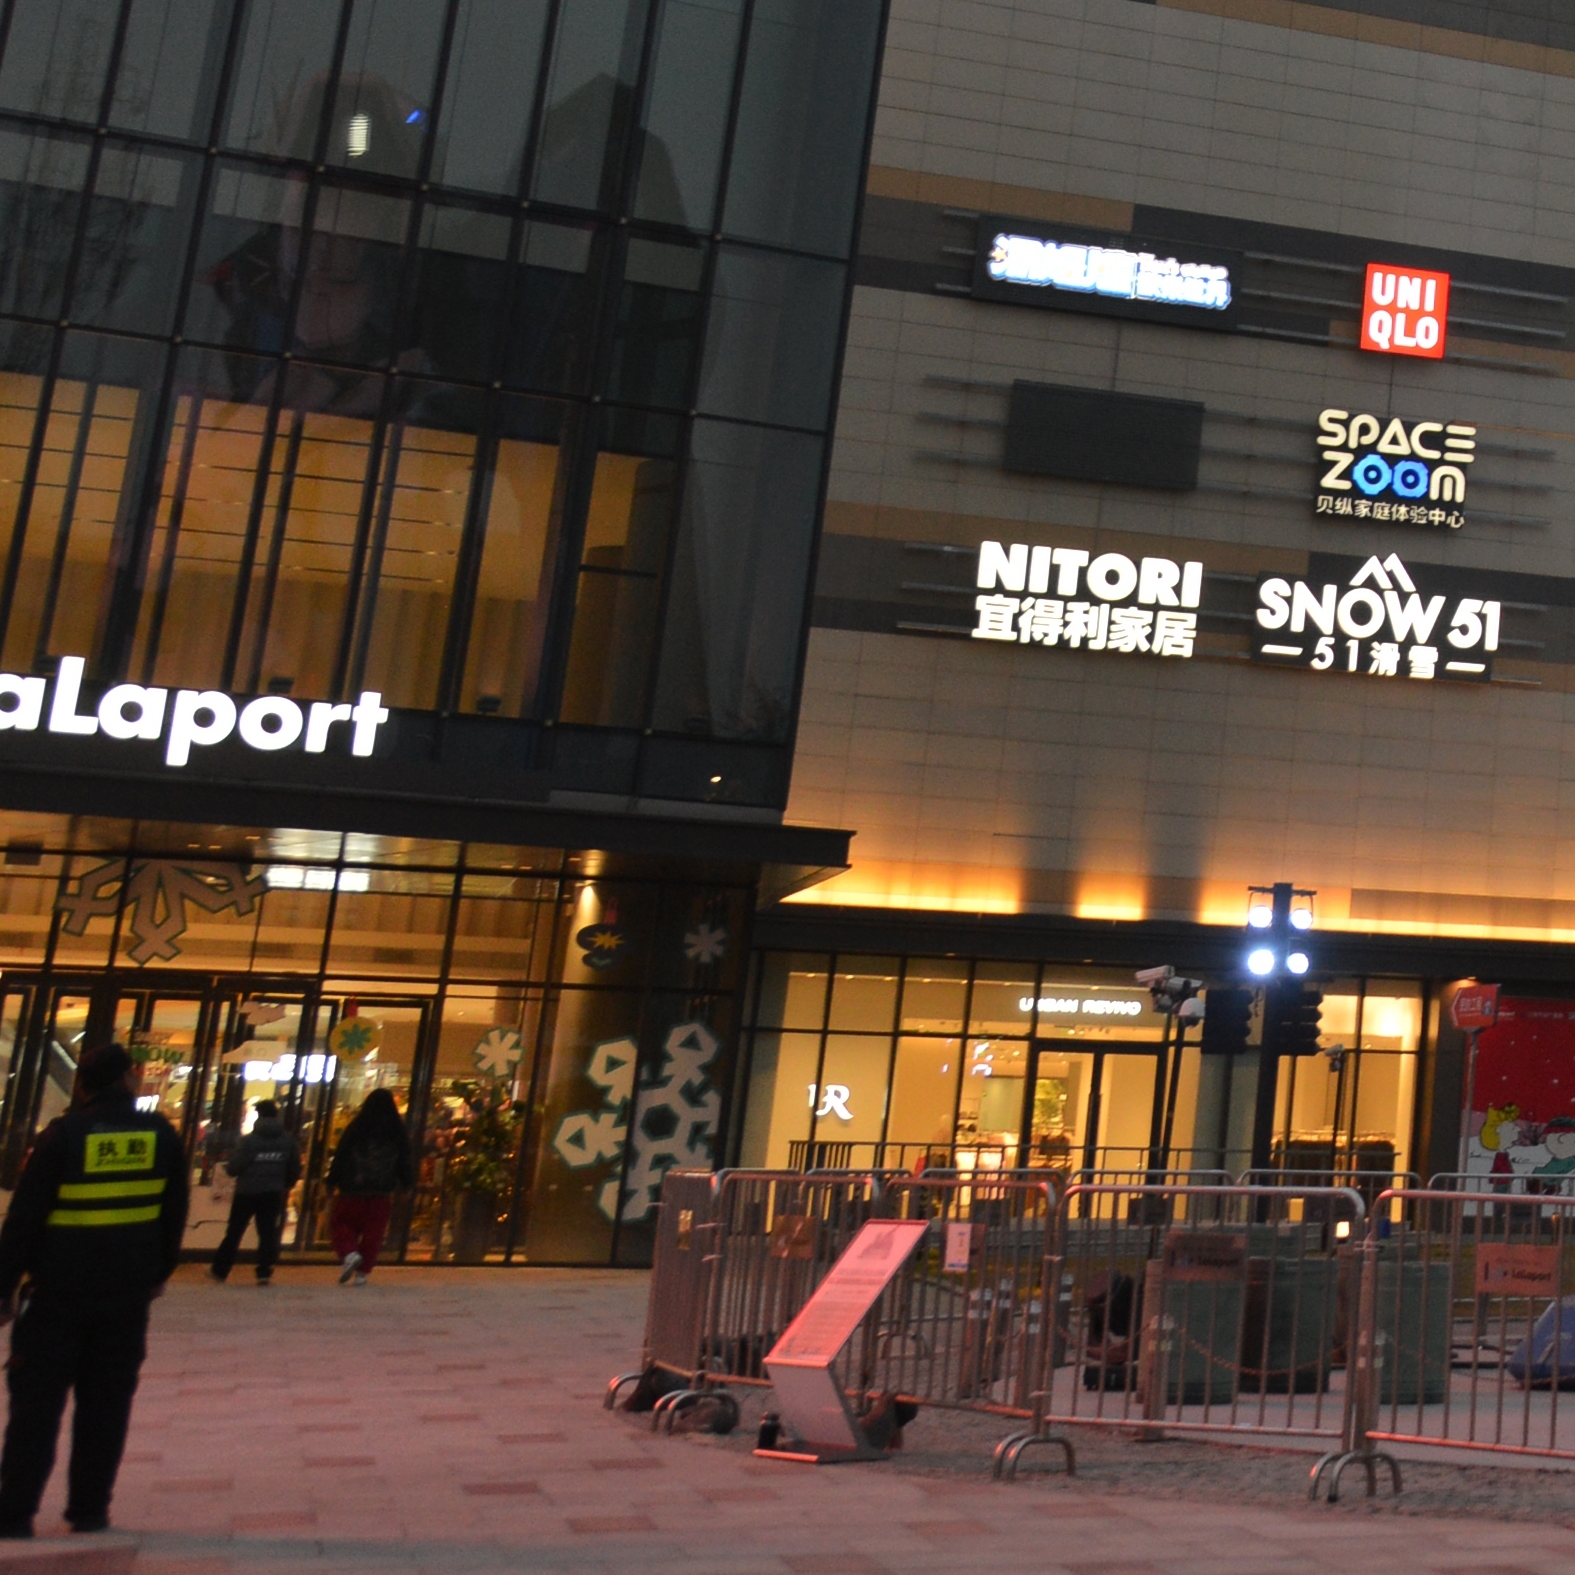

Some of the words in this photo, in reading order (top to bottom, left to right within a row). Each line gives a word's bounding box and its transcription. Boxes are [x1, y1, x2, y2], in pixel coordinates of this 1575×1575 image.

[1370, 271, 1437, 313] UNI
[1367, 312, 1440, 350] QLO
[1317, 409, 1477, 463] SPACE
[1319, 450, 1467, 504] ZOOM
[1316, 494, 1465, 530] 贝纵家庭体验中心
[976, 540, 1204, 609] NITORI
[971, 593, 1199, 659] 宜得利家居
[1255, 577, 1447, 644] SNOW
[1446, 598, 1501, 652] 51
